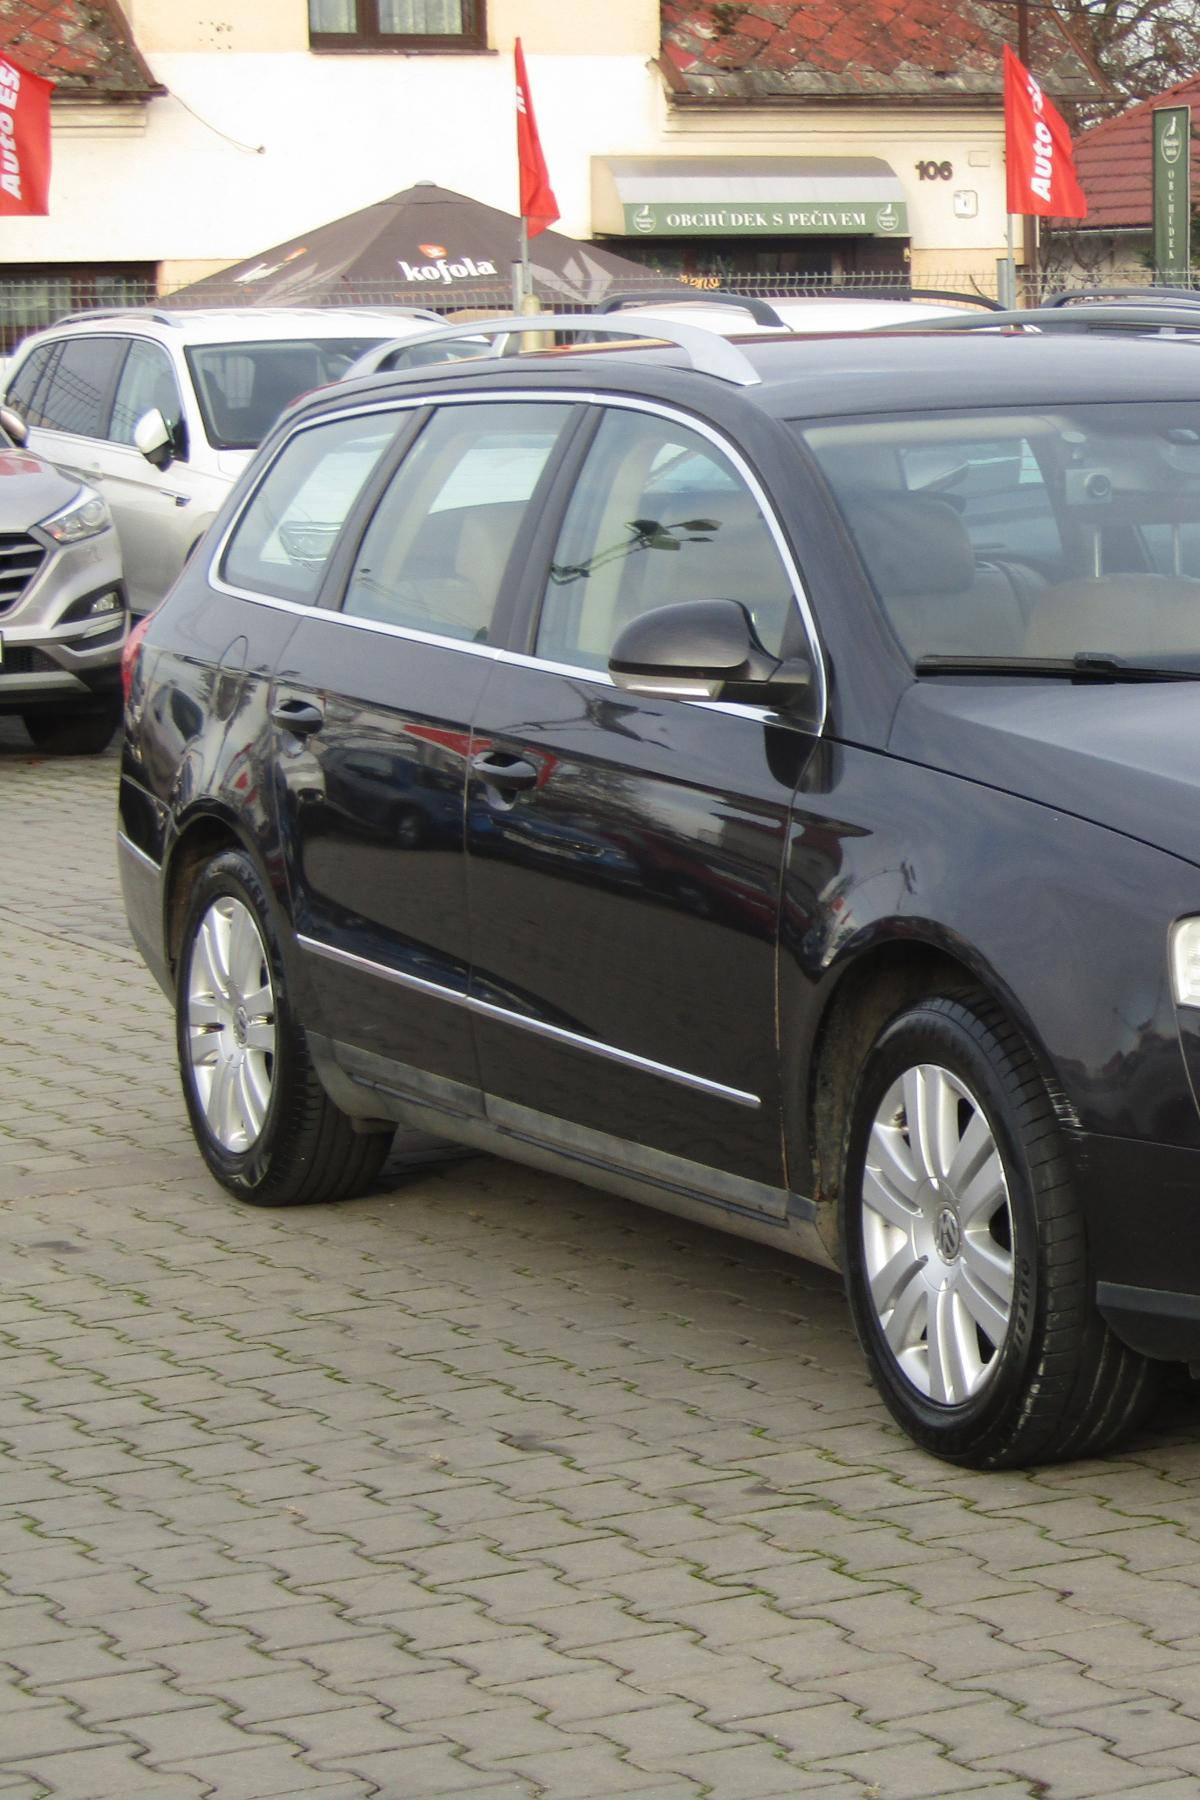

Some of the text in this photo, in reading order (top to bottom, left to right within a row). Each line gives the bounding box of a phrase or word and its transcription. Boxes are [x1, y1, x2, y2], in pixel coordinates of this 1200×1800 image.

[0, 111, 22, 200] Auto
[1030, 121, 1053, 203] Auto
[914, 160, 953, 181] 106
[772, 213, 784, 226] S
[788, 210, 867, 226] PEČIVEM
[397, 257, 498, 284] kofola
